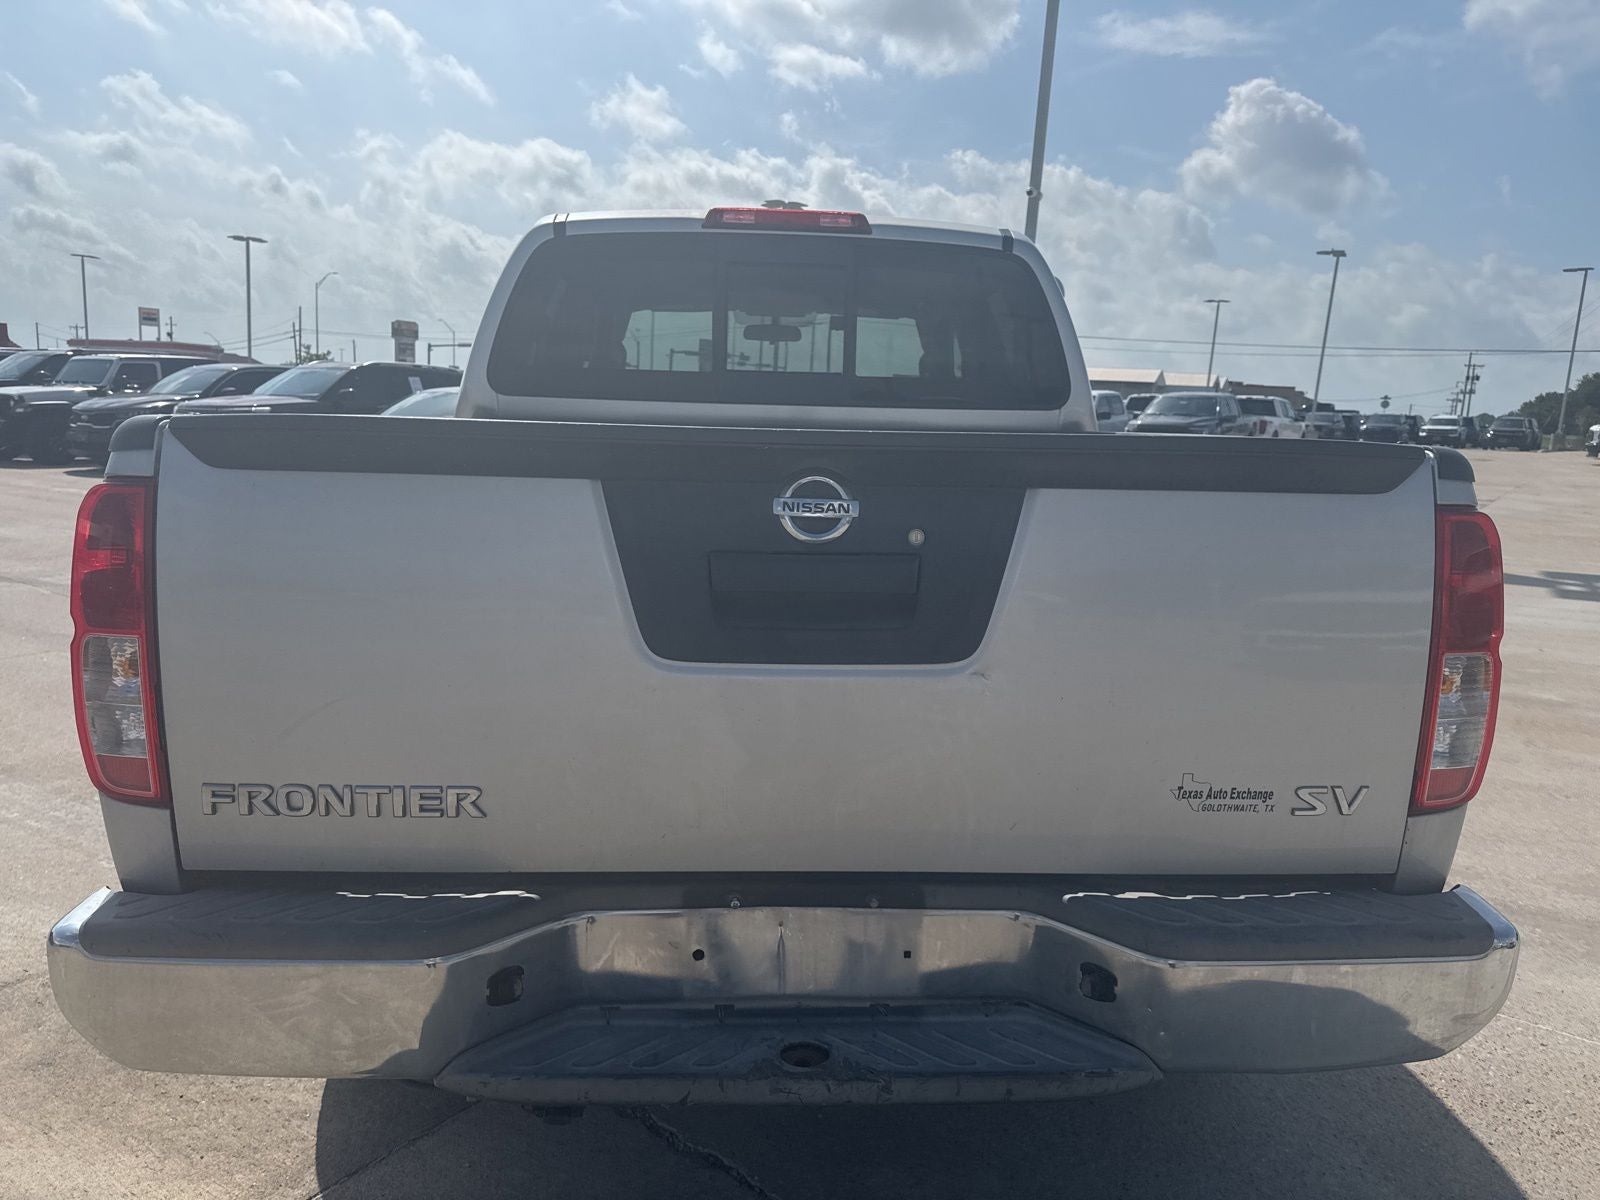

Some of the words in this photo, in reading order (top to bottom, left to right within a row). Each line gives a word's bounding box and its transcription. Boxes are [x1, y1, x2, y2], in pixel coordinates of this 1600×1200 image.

[782, 501, 850, 514] NISSAN
[201, 782, 487, 818] FRONTIER
[1177, 786, 1204, 800] Texas
[1205, 786, 1228, 800] Auto
[1229, 787, 1274, 803] Exchange
[1291, 785, 1370, 816] SV
[1264, 804, 1275, 813] TX
